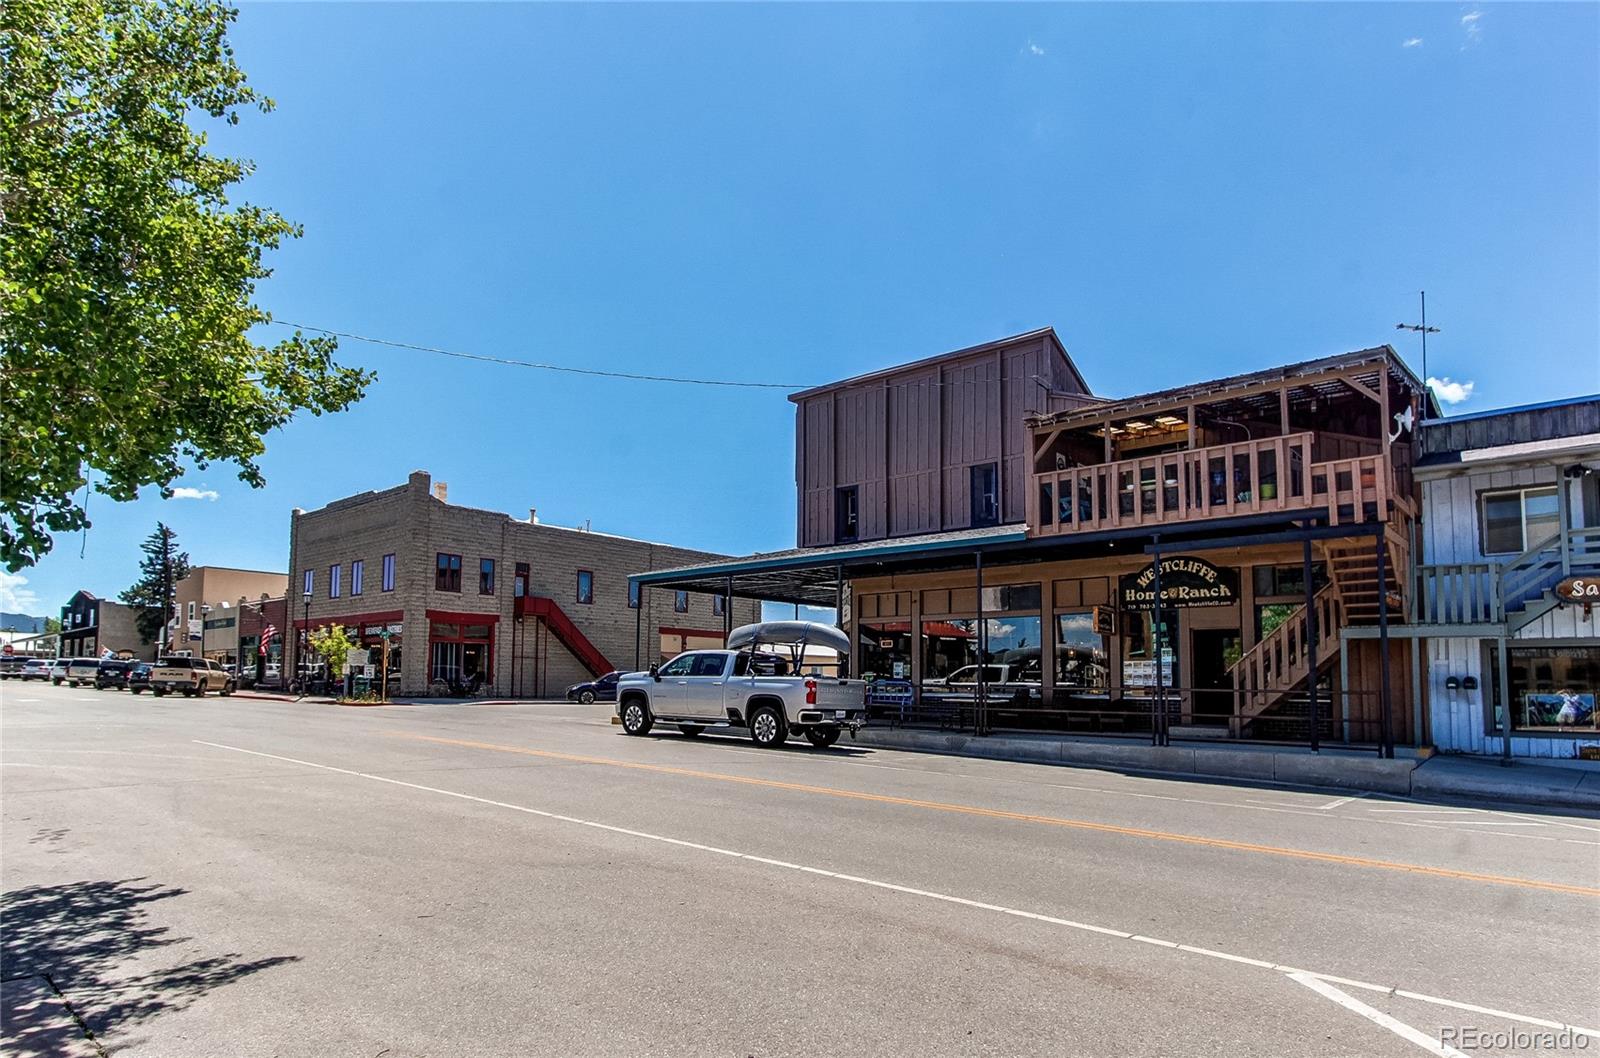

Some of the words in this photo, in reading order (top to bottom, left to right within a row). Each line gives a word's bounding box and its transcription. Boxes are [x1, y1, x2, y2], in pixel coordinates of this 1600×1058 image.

[1137, 560, 1218, 588] WESTCLIFFE
[1125, 589, 1169, 601] Home
[1178, 584, 1231, 600] Ranch
